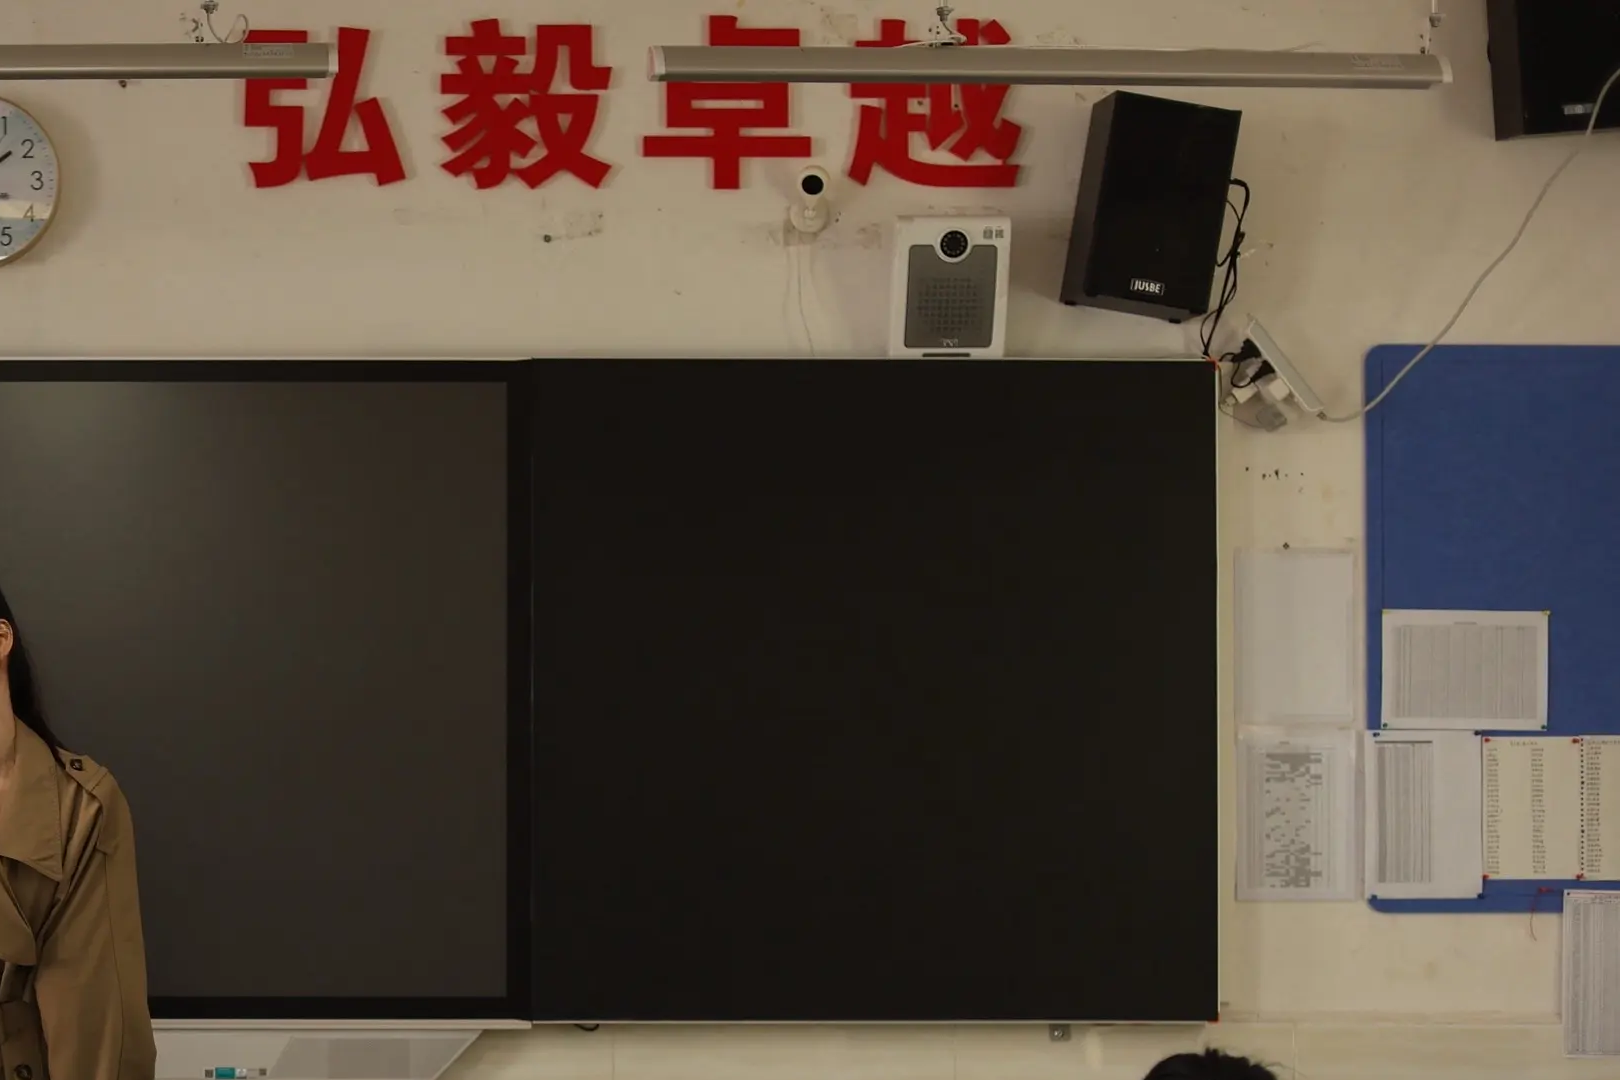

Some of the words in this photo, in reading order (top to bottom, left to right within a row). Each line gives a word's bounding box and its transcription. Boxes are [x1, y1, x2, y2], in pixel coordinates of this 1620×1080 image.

[242, 15, 1021, 191] 弘毅卓越
[1, 116, 8, 135] 1
[21, 139, 34, 158] 2
[31, 171, 43, 190] 3
[22, 204, 36, 222] 4
[0, 227, 12, 246] 5
